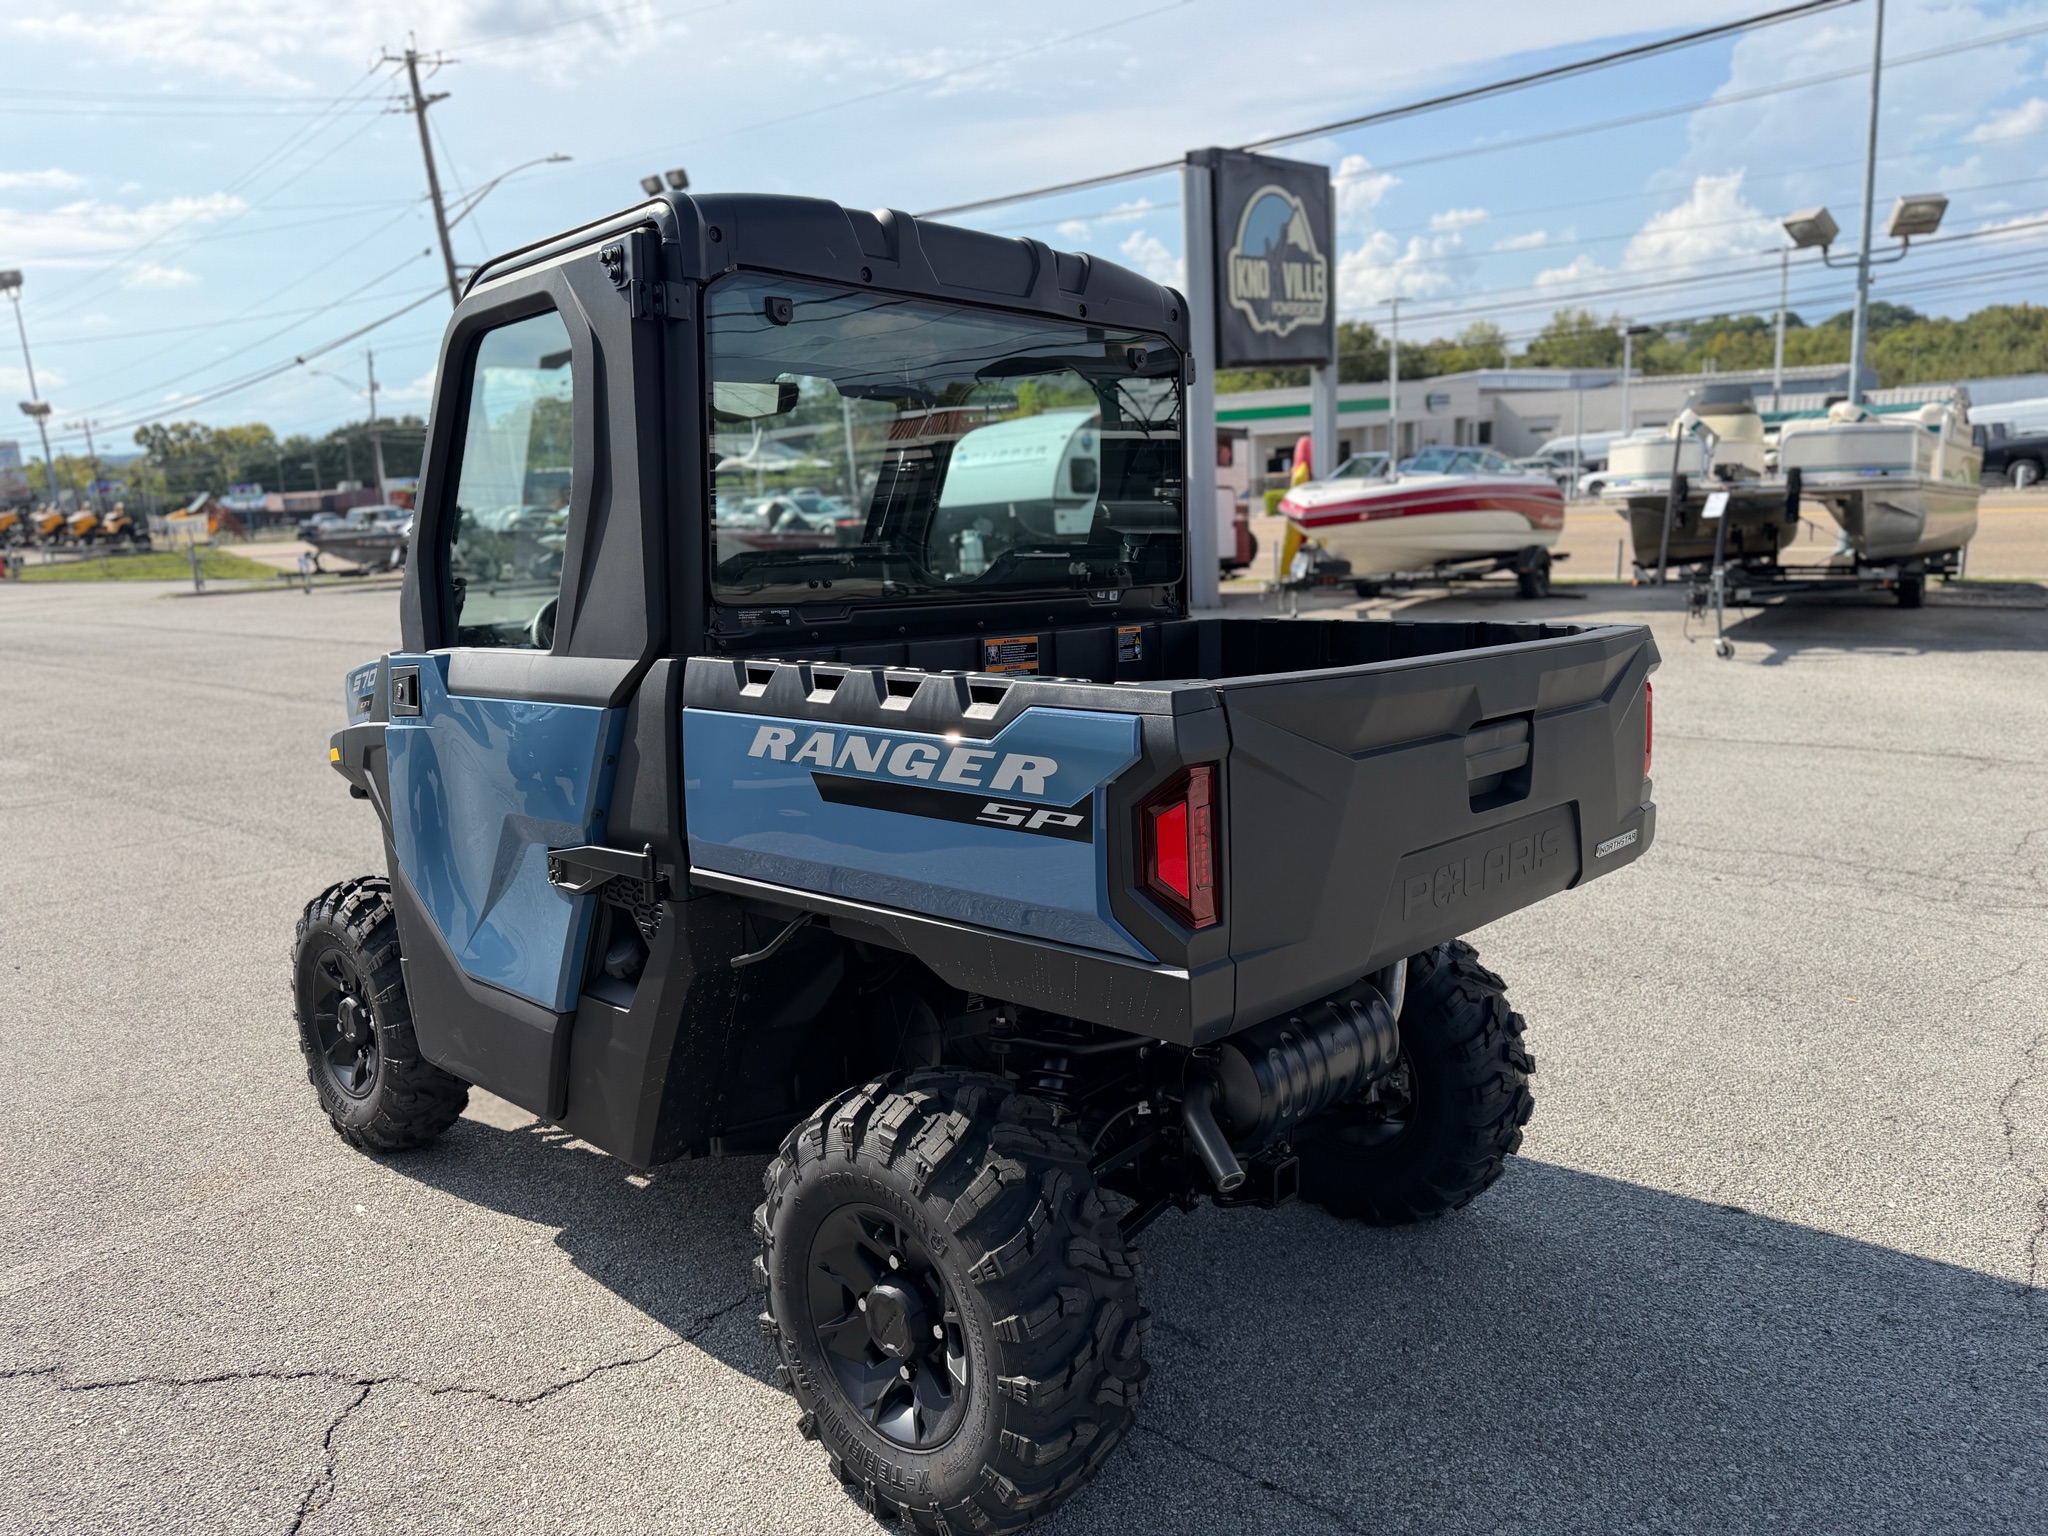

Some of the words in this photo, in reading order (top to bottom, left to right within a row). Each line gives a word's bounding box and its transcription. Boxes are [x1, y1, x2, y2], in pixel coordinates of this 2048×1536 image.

[352, 667, 378, 693] 570
[747, 725, 1059, 796] RANGER
[975, 802, 1085, 829] SP
[1598, 831, 1638, 857] NORTHSTAR
[1402, 825, 1562, 921] POLARIS
[813, 1394, 933, 1496] X-TERRAIN
